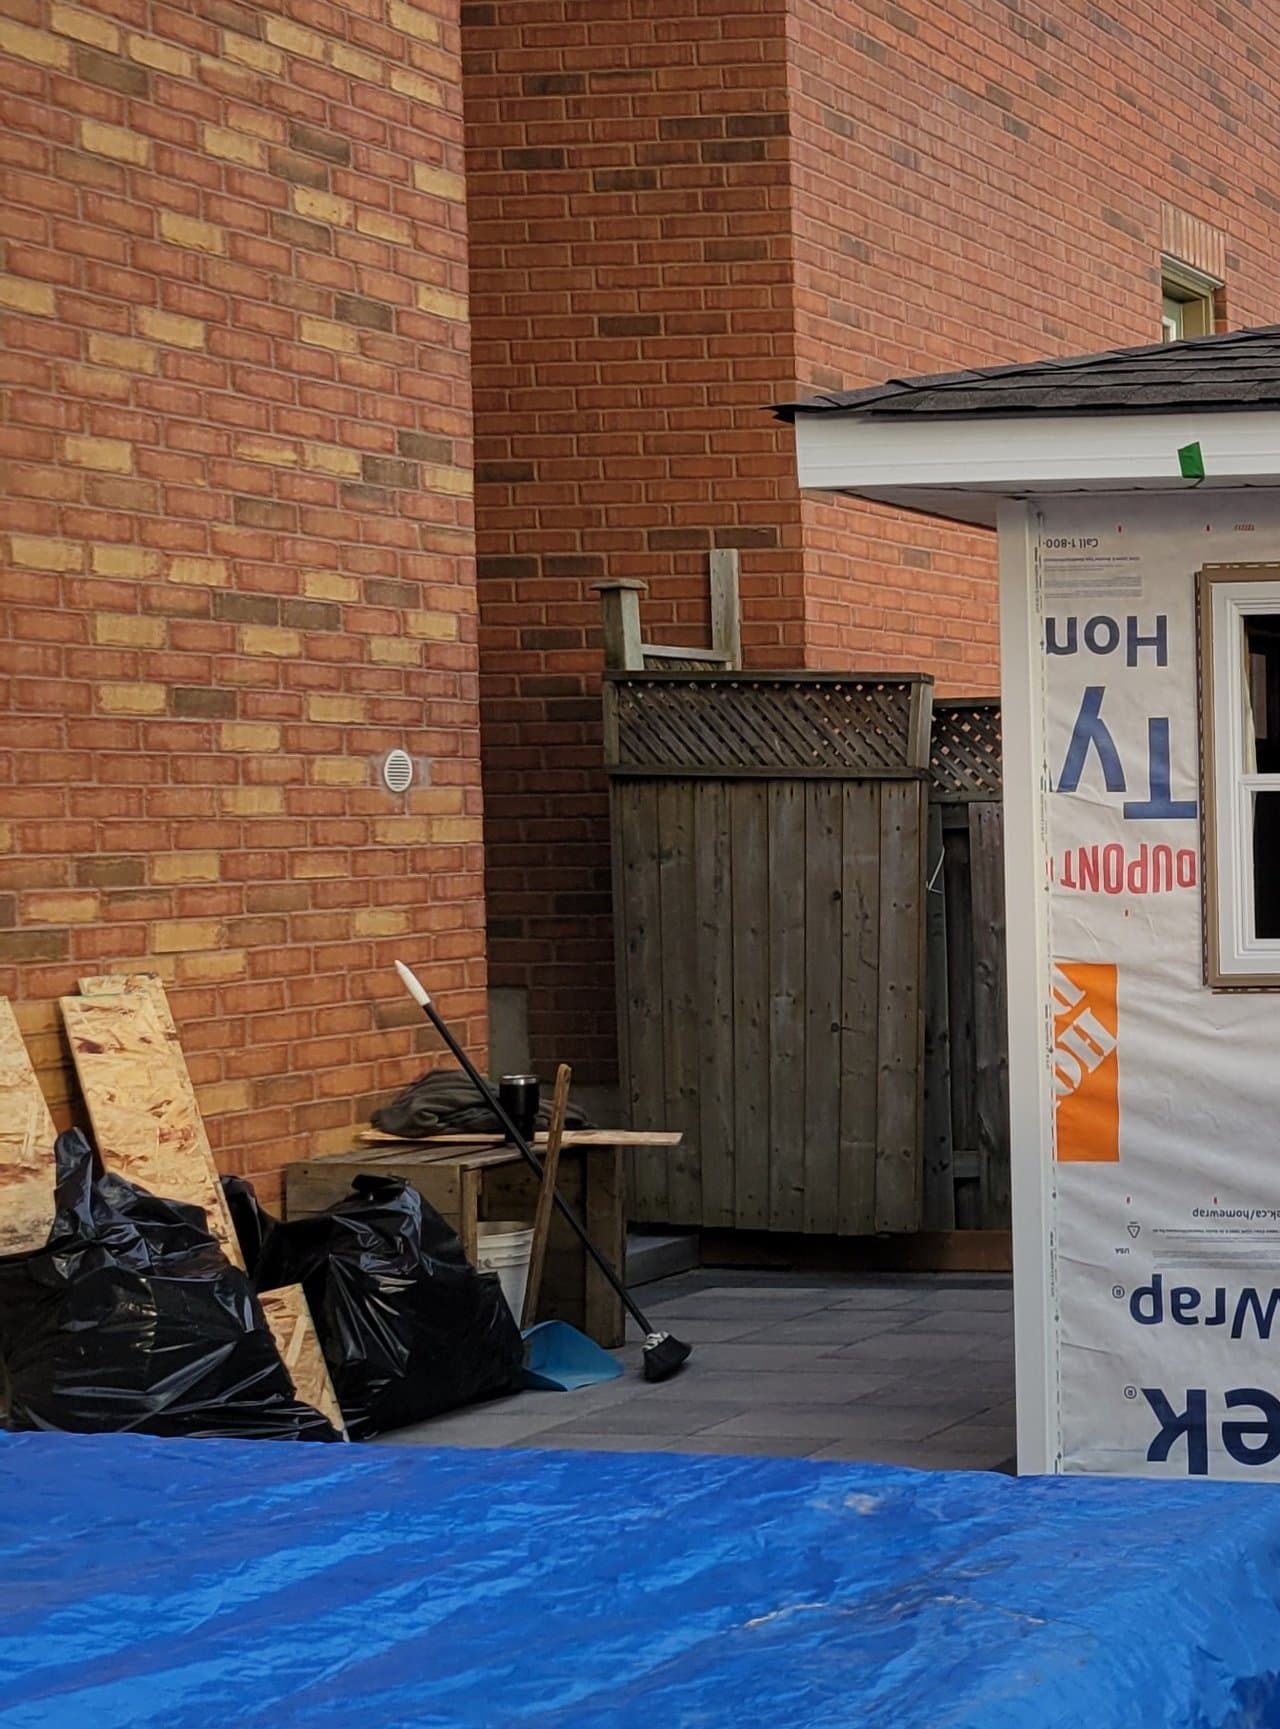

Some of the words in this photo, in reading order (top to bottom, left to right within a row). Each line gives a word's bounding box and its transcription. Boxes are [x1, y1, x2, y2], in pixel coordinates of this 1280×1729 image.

[1078, 537, 1099, 549] Call
[1048, 686, 1197, 819] Ty
[1060, 843, 1196, 894] DUPONT
[1114, 1247, 1130, 1255] USA
